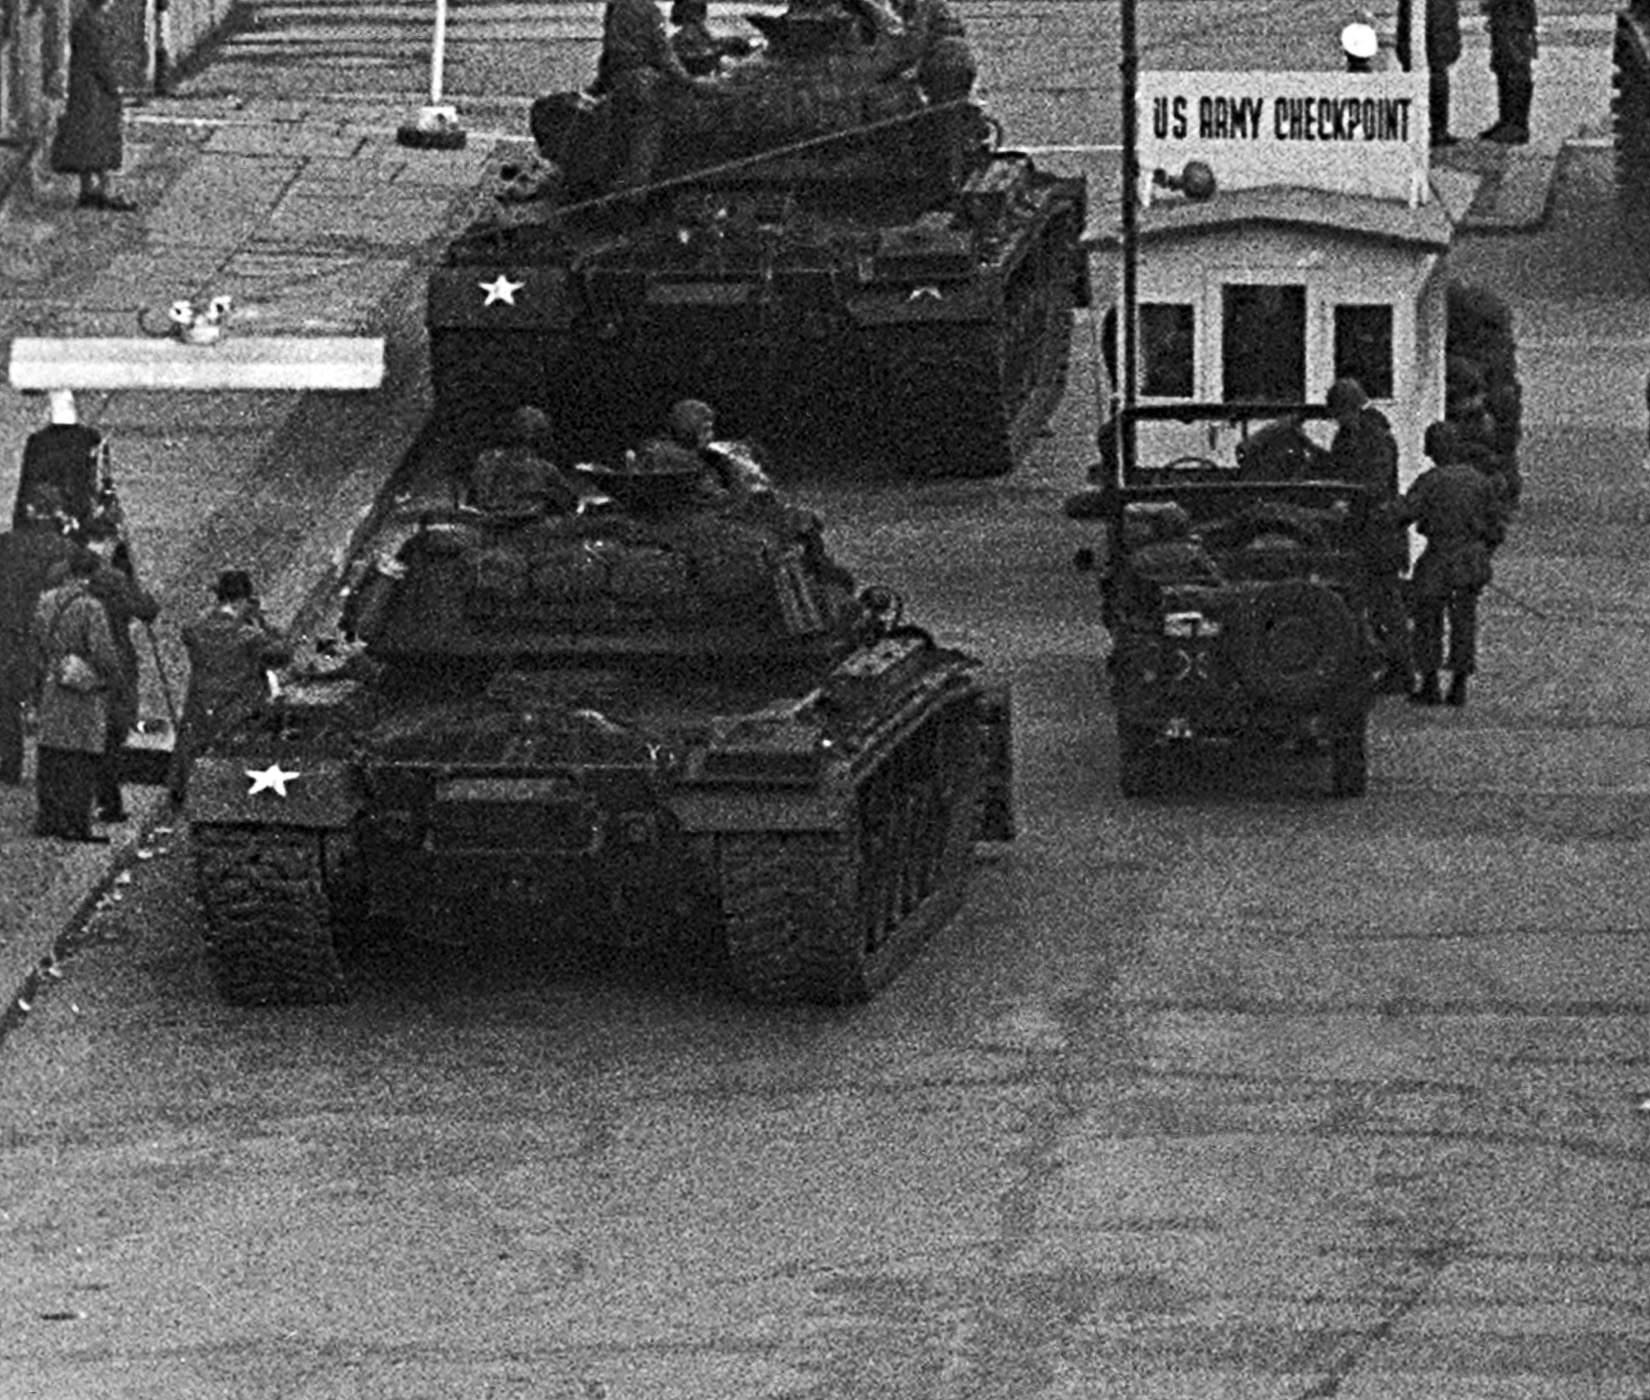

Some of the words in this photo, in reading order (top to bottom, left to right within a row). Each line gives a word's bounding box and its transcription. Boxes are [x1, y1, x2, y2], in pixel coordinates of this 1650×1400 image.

[1153, 96, 1188, 140] US
[1199, 96, 1264, 140] ARMY
[1274, 96, 1413, 142] CHECKPOINT
